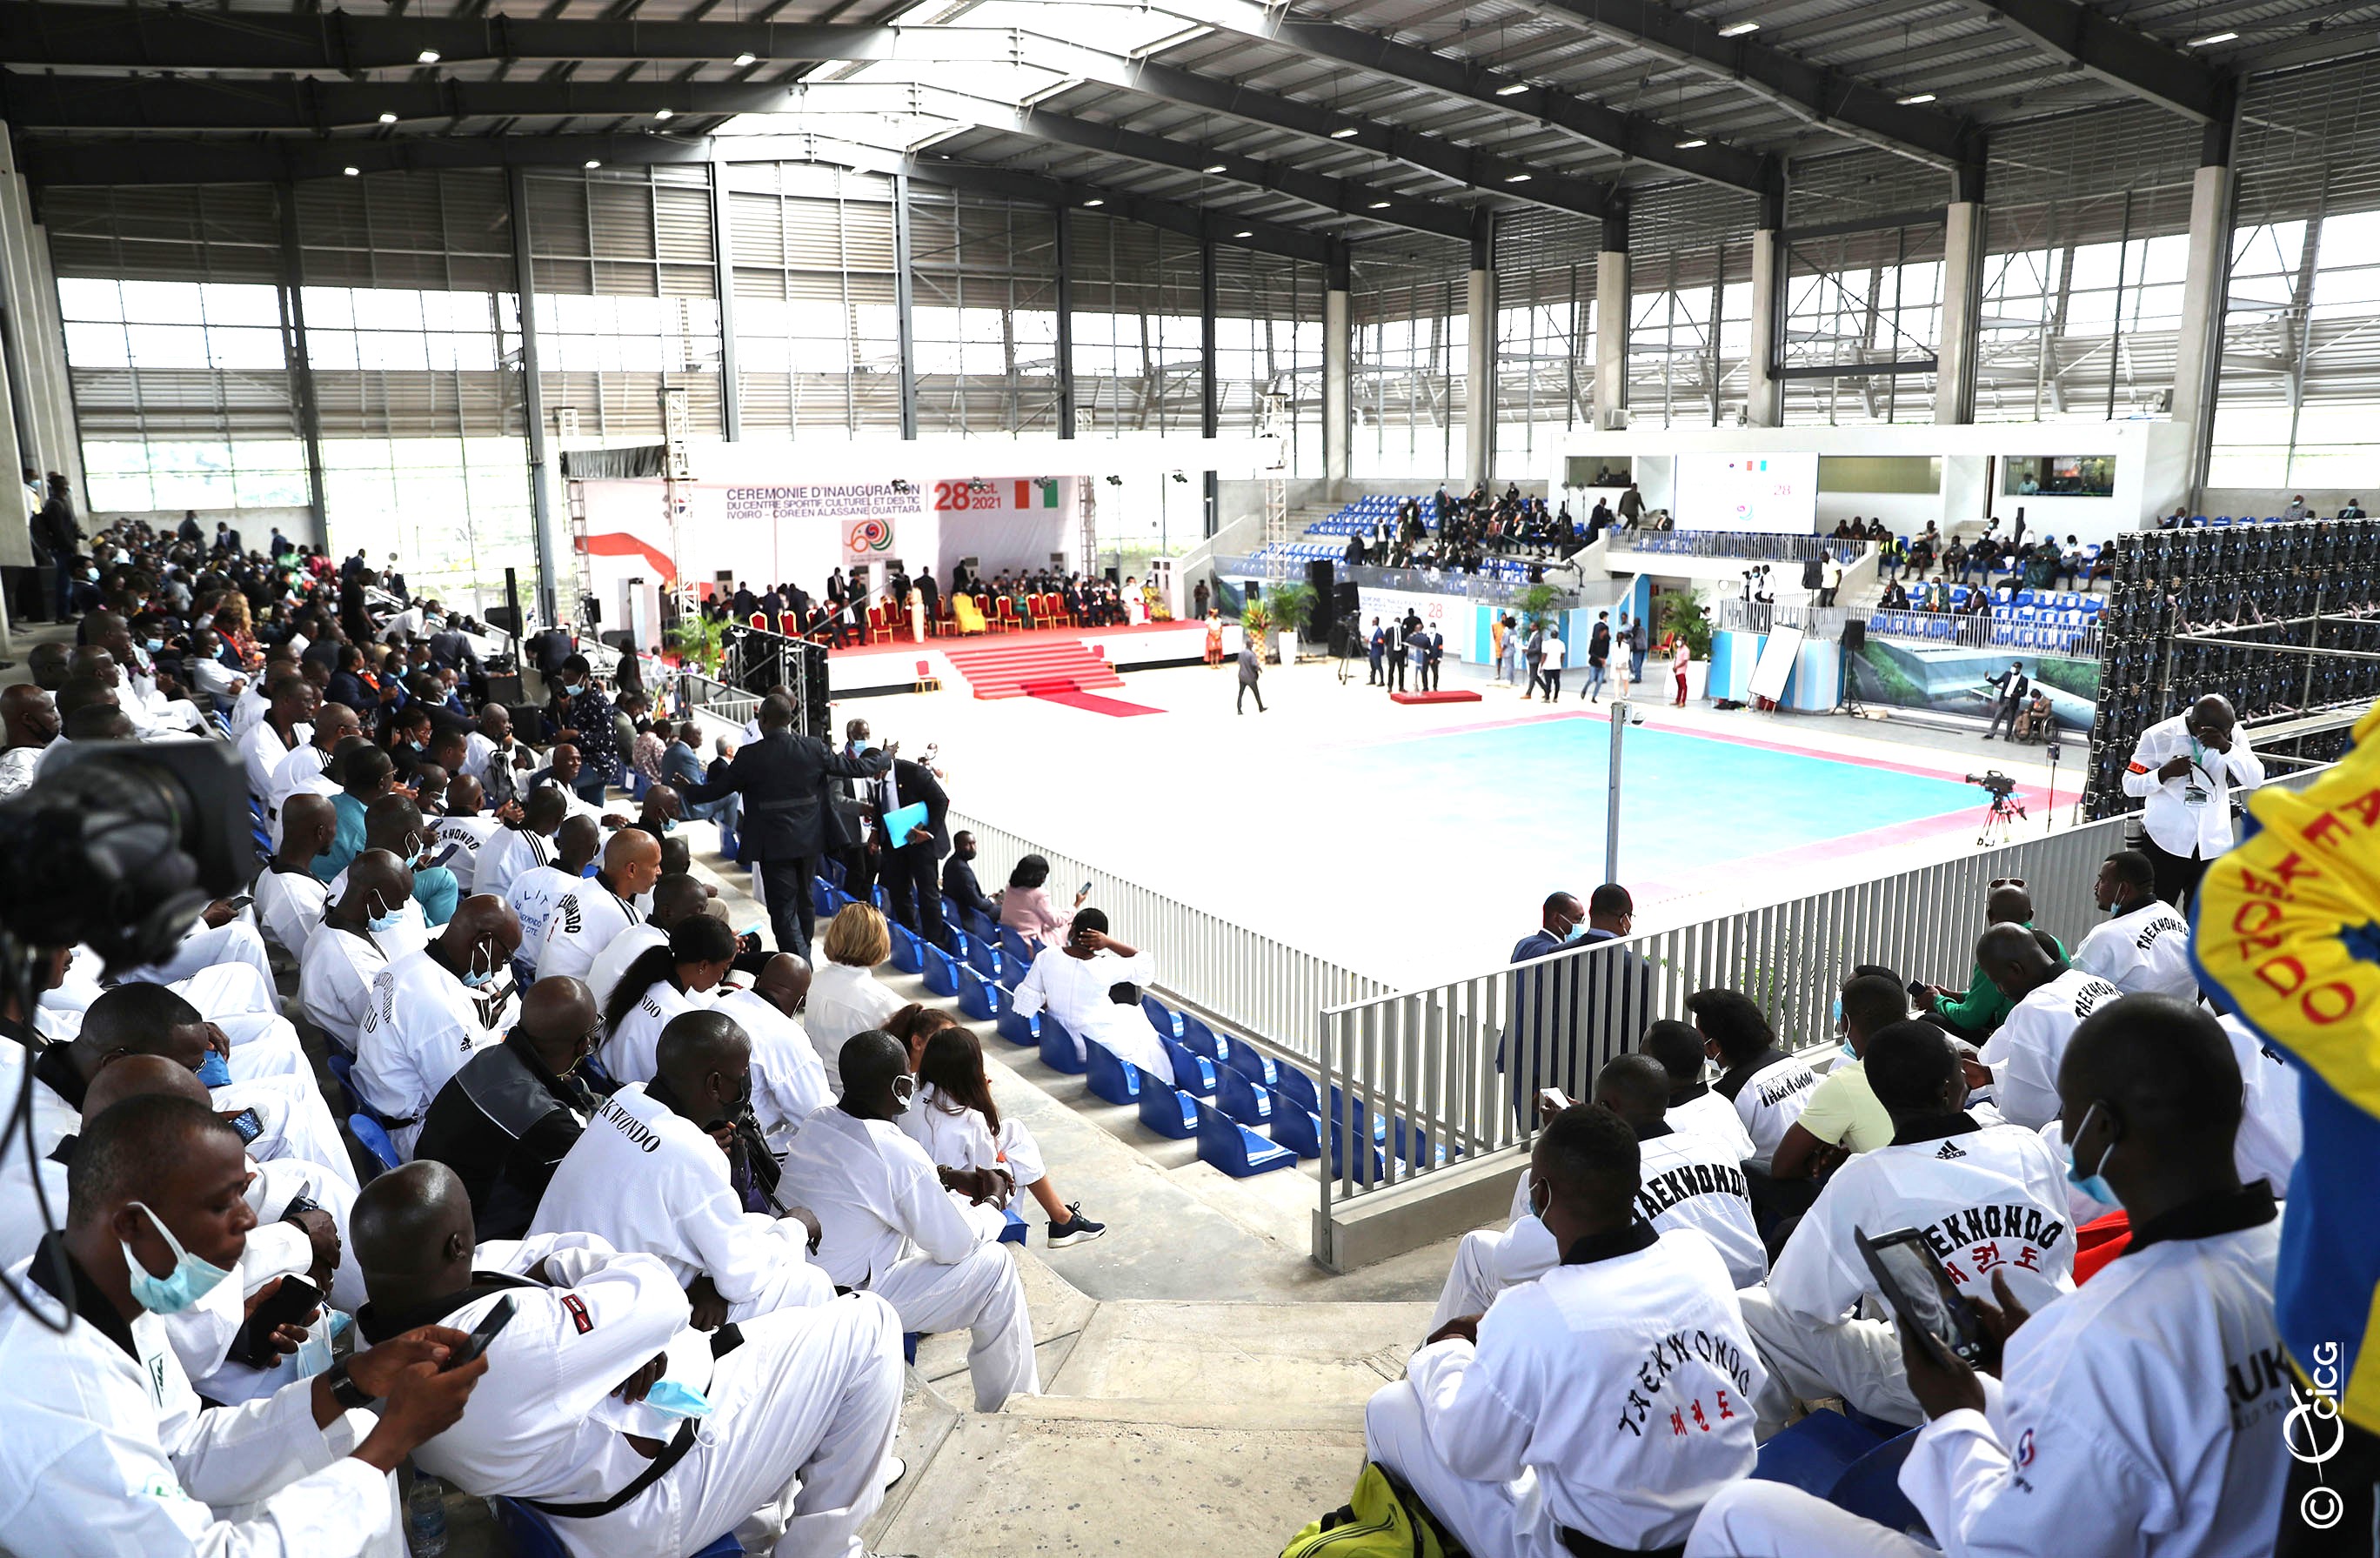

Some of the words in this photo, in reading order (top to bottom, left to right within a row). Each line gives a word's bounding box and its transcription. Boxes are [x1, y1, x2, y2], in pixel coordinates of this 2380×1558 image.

[726, 486, 808, 500] CEREMONIE
[812, 485, 920, 498] D'INAUGURAON
[933, 482, 970, 511] 28
[726, 500, 741, 511] DU
[742, 500, 781, 510] CENTRE
[826, 498, 871, 508] CULTUREL
[874, 497, 885, 505] ET
[886, 497, 905, 505] DES
[907, 496, 919, 505] TIC
[972, 497, 1001, 510] 2021
[726, 510, 762, 519] IVOIRO
[772, 508, 816, 518] COREEN
[817, 507, 870, 518] ALASSANE
[872, 505, 921, 515] OUATTARA
[1428, 602, 1443, 619] 28
